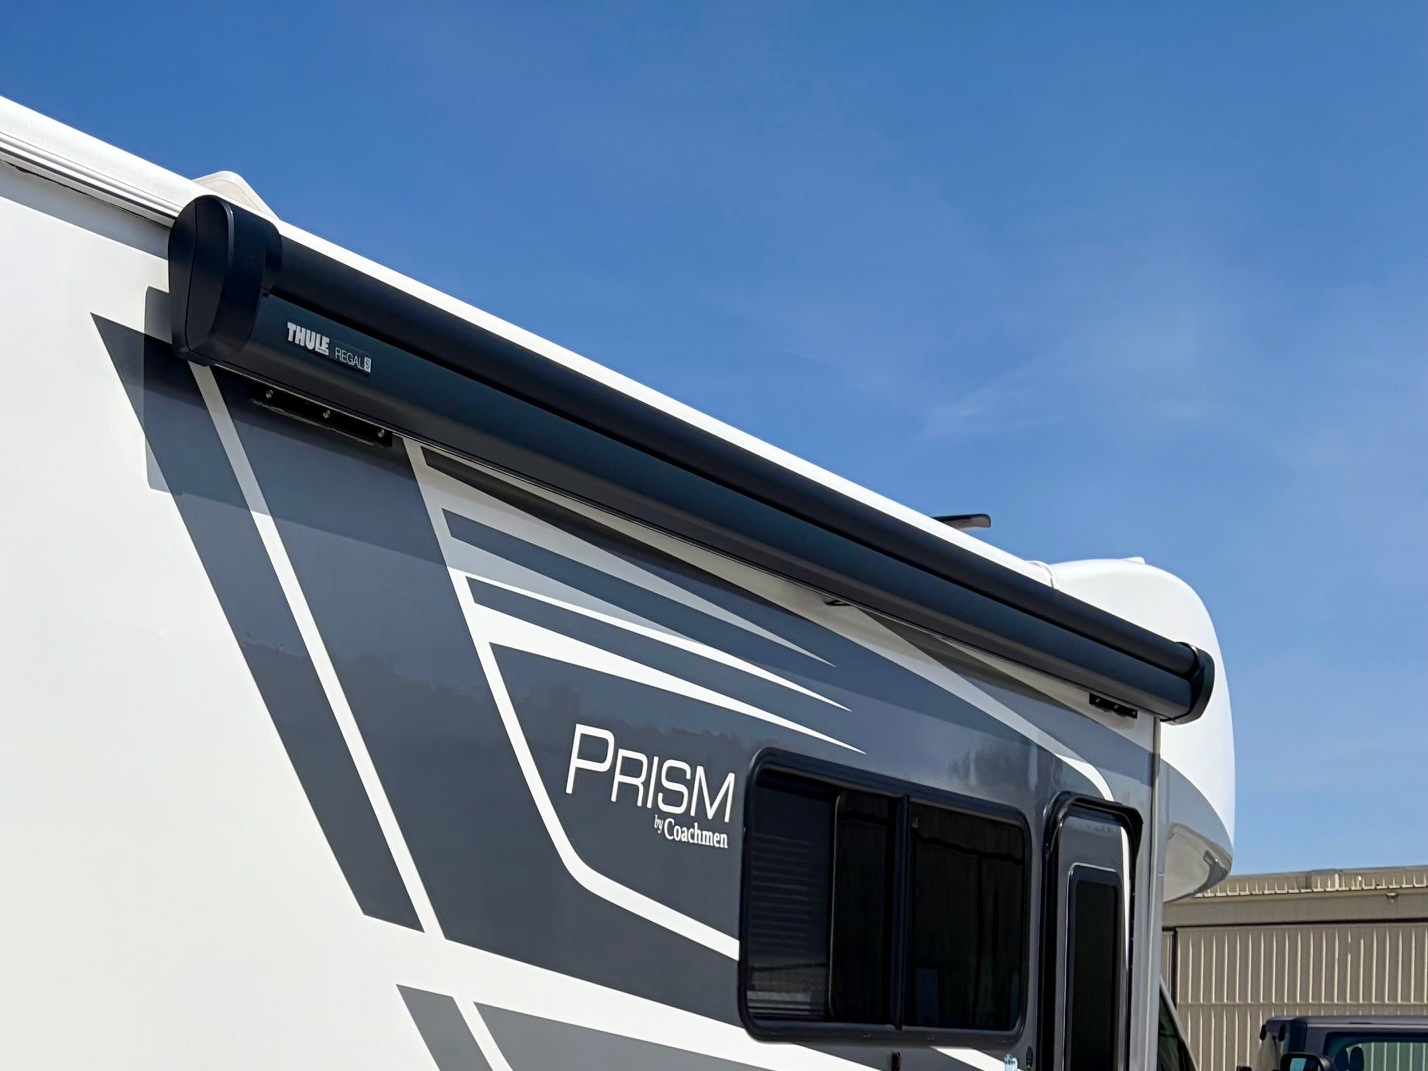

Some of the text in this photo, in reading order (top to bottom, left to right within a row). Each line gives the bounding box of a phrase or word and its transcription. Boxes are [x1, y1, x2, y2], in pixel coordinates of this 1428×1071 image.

[286, 321, 330, 356] THULE
[335, 346, 364, 370] REGAL
[565, 723, 736, 823] PRISM
[653, 814, 729, 849] by Coachmen
